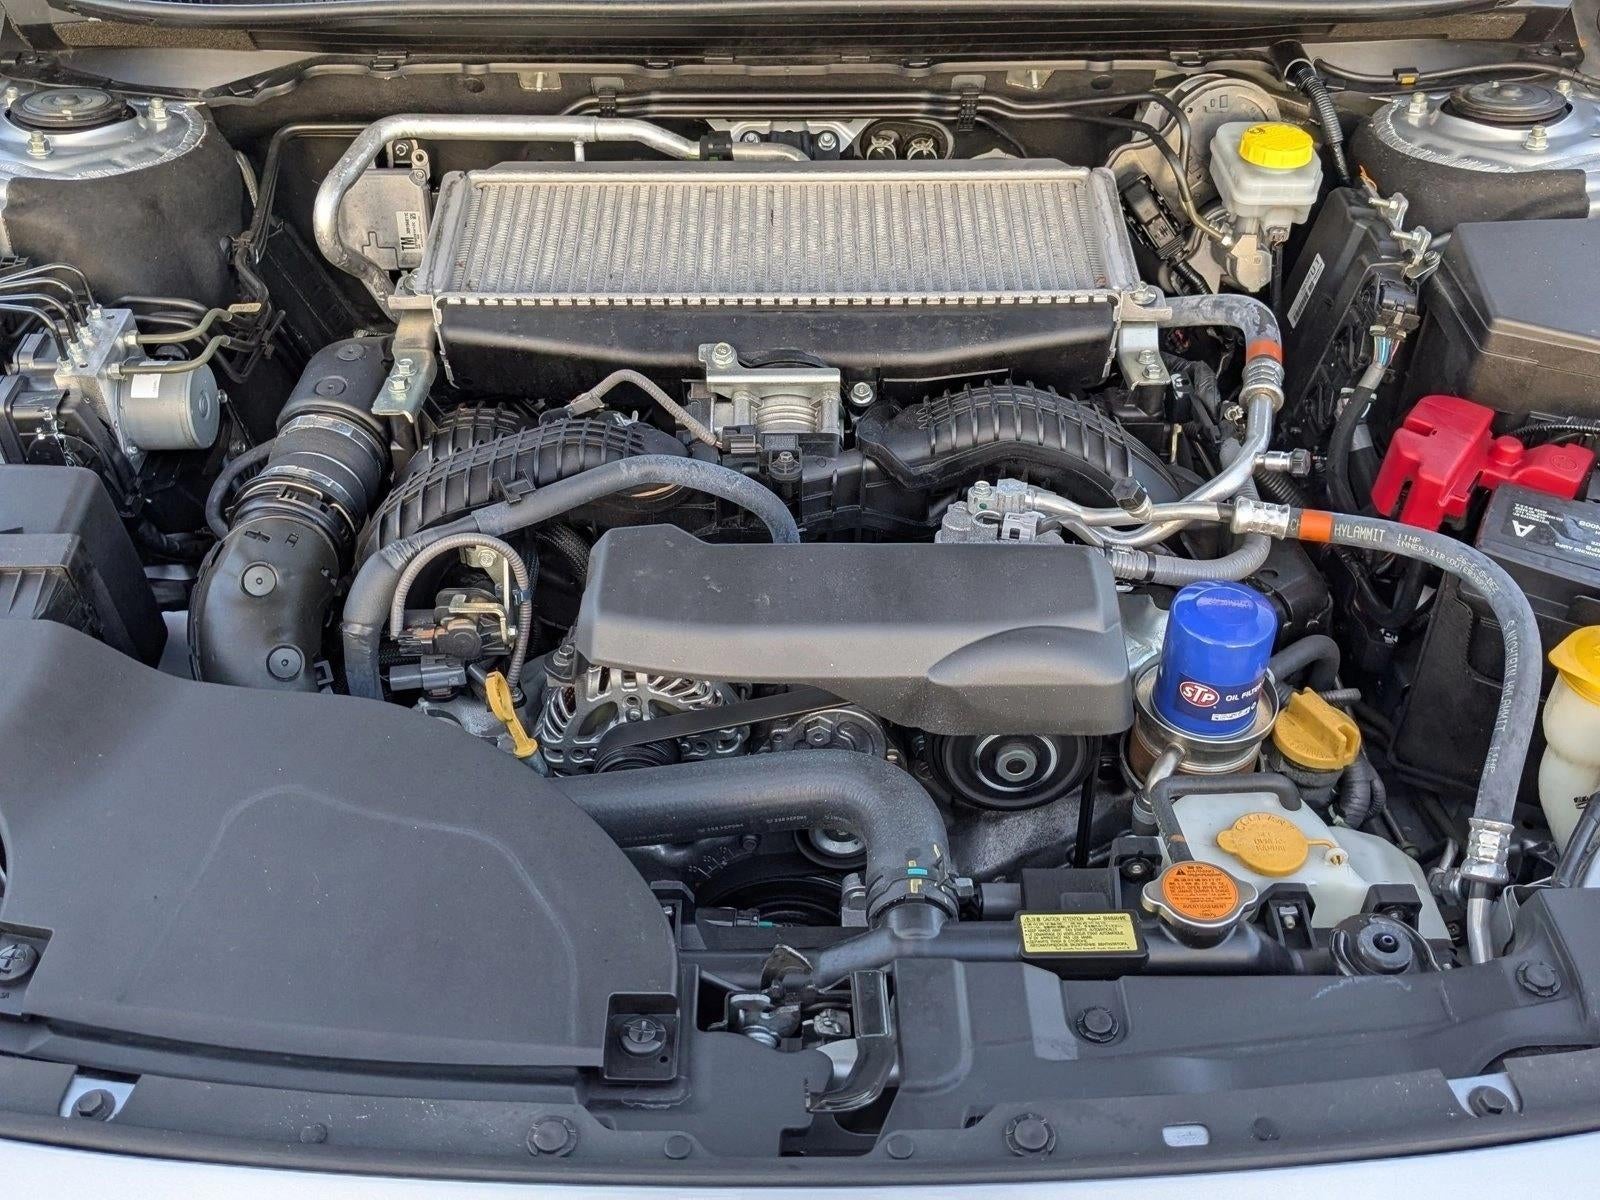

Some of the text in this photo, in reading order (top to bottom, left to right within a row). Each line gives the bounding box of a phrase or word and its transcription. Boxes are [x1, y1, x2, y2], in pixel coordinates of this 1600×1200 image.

[1334, 522, 1386, 544] HYLAMMIT
[1512, 520, 1537, 537] A
[1184, 683, 1216, 703] STP
[1225, 694, 1240, 702] OIL
[1494, 680, 1516, 733] HYLAMMIT
